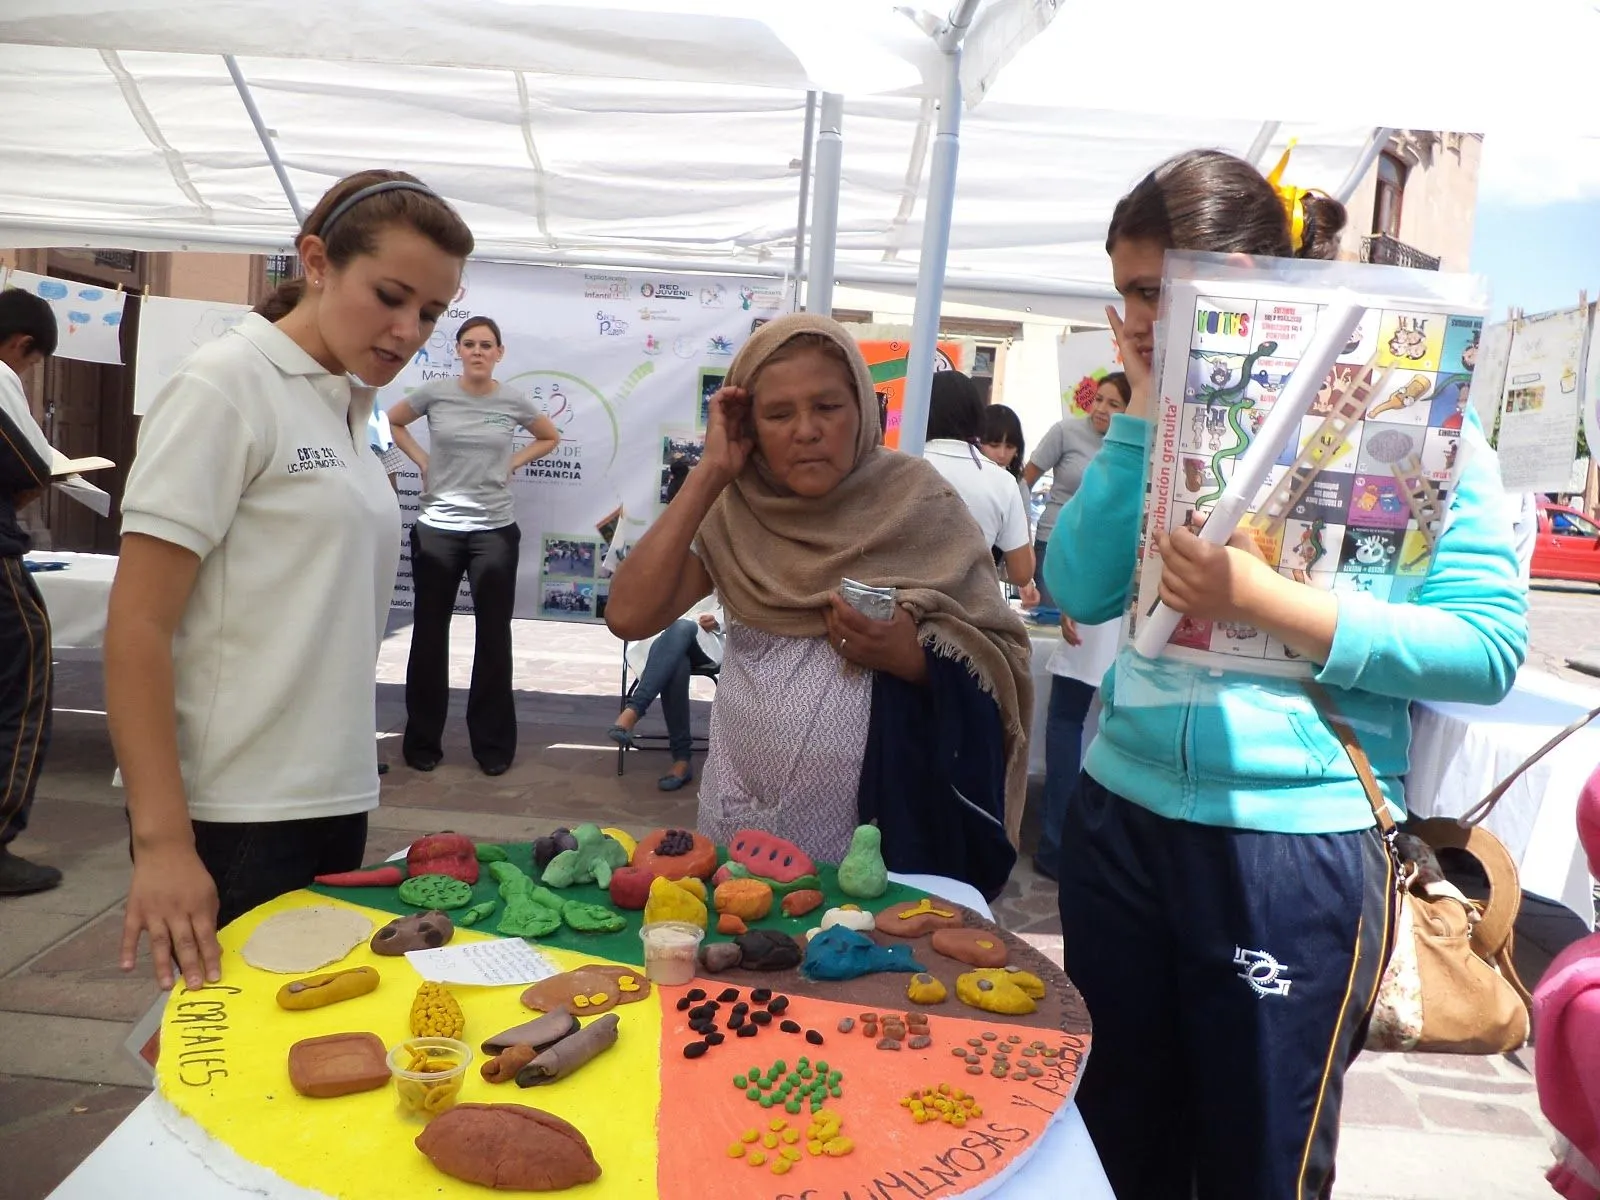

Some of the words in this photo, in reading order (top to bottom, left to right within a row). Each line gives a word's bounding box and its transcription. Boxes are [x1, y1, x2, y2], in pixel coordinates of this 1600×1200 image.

[1197, 310, 1250, 338] SALIDA
[564, 446, 582, 458] DE
[574, 462, 582, 470] A
[525, 468, 582, 480] INFANCIA
